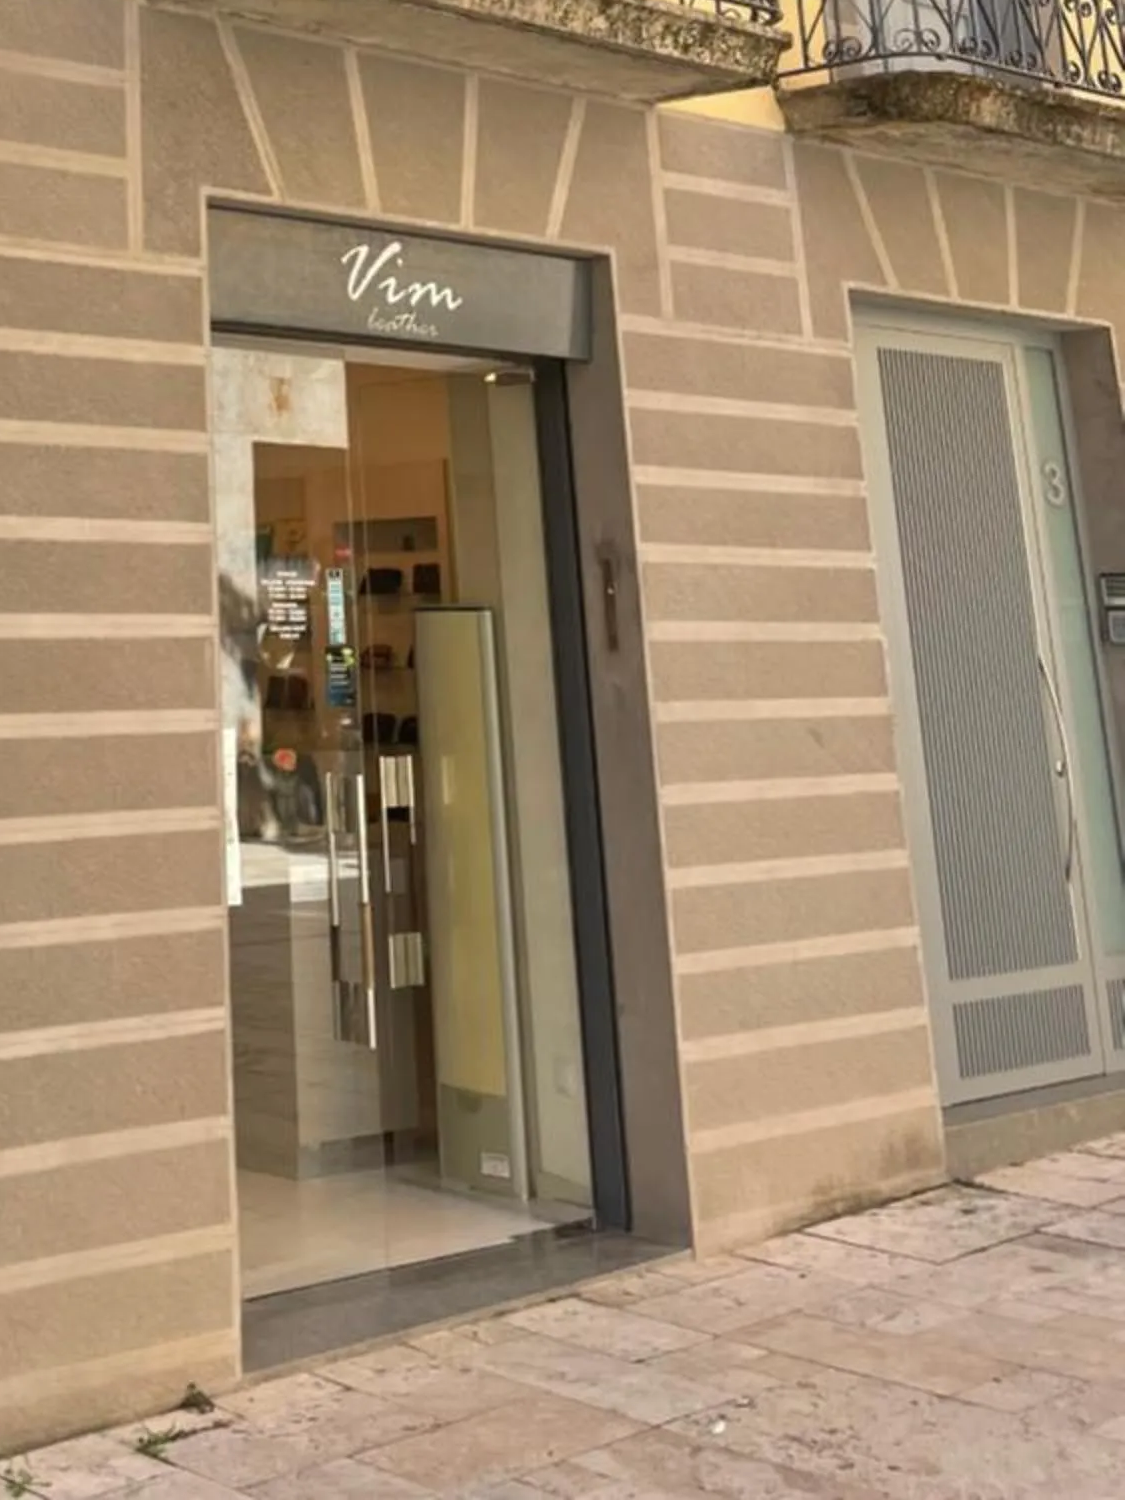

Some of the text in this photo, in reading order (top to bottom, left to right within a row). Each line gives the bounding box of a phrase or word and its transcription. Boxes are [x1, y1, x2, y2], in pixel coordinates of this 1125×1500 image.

[340, 241, 463, 310] Vim
[366, 307, 439, 337] leather
[1044, 460, 1066, 506] 3
